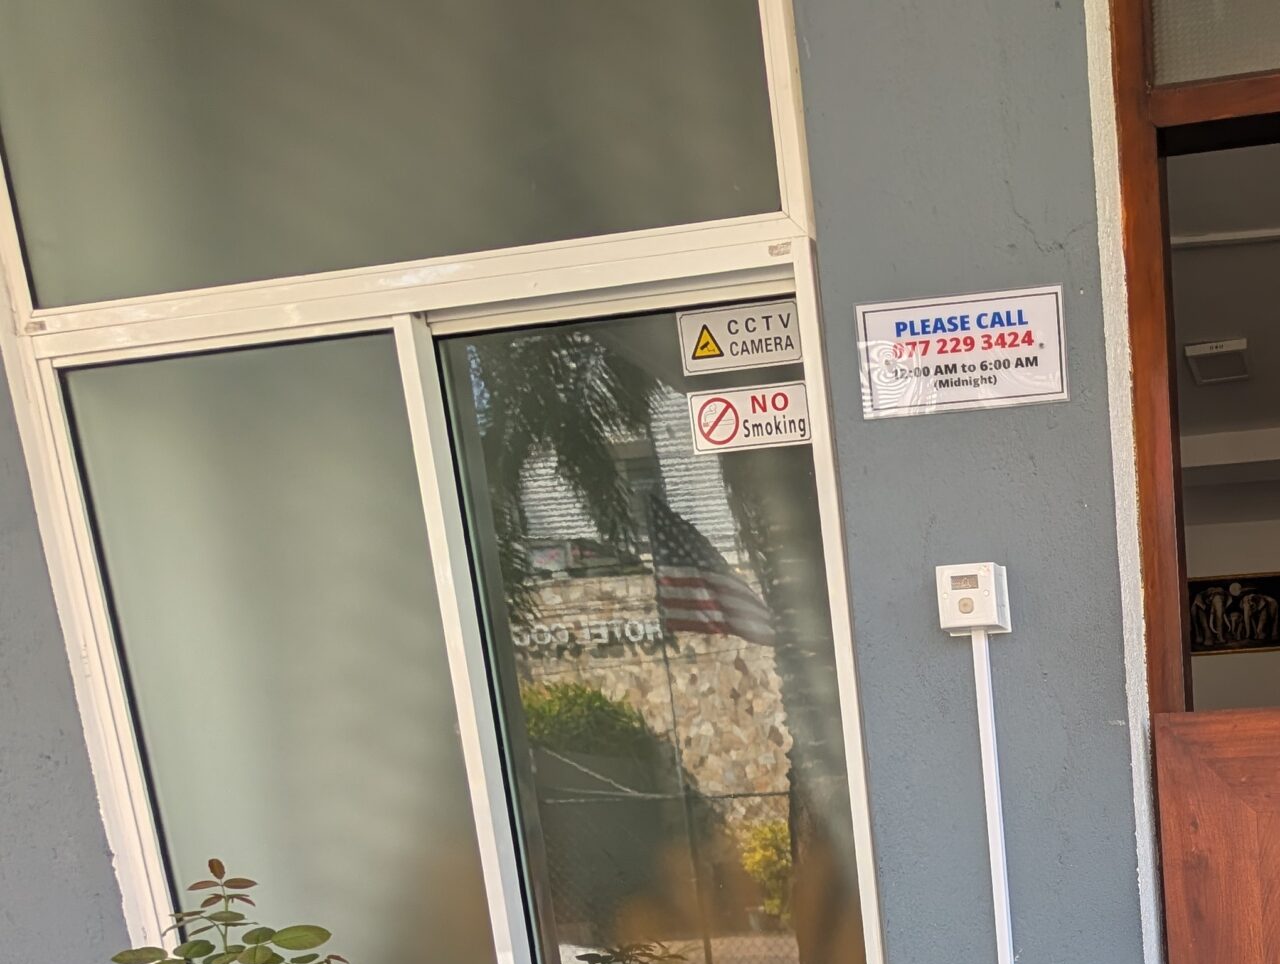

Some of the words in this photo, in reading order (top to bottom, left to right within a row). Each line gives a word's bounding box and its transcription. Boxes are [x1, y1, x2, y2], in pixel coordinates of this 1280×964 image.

[727, 313, 791, 335] CCTV
[895, 315, 971, 338] PLEASE
[976, 309, 1029, 330] CALL
[729, 335, 795, 357] CAMERA
[936, 335, 975, 355] 229
[981, 330, 1035, 351] 3424
[934, 363, 958, 377] AM
[961, 361, 976, 374] to
[980, 359, 1011, 372] 6:00
[1014, 356, 1039, 369] AM
[934, 374, 997, 390] (Midnight)
[751, 392, 789, 414] NO
[743, 414, 806, 438] Smoking
